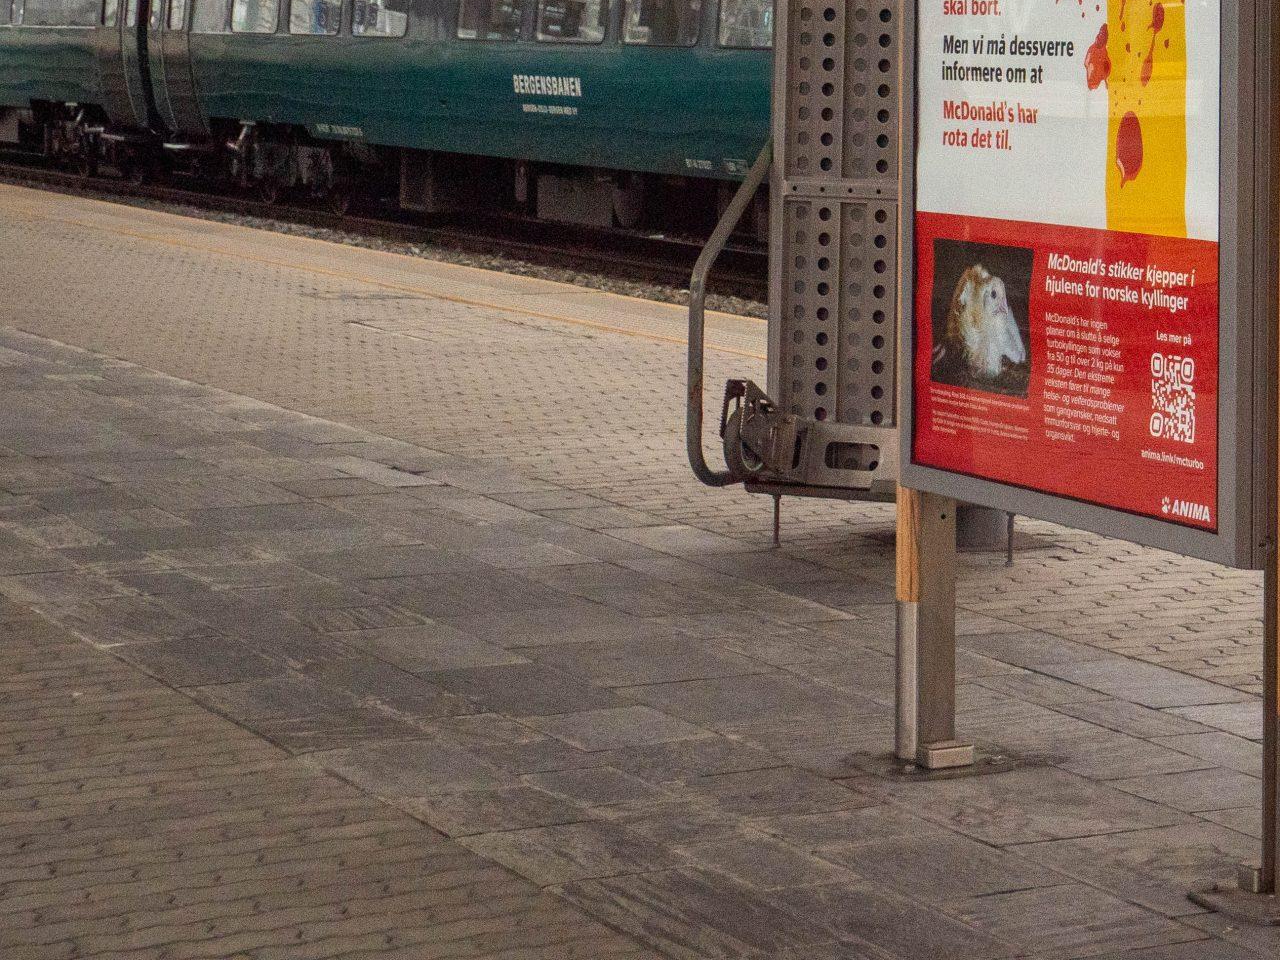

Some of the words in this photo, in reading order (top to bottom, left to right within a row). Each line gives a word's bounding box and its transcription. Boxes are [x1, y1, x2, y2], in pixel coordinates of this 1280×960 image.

[513, 75, 581, 96] BERGENSBANEN
[1048, 253, 1105, 276] McDonald's
[1109, 261, 1144, 281] stikker
[1146, 265, 1188, 288] kjepper
[1191, 269, 1195, 286] i
[1046, 276, 1083, 296] hjulene
[1085, 281, 1100, 298] for
[1103, 287, 1138, 303] norske
[1142, 288, 1188, 313] kyllinger
[1172, 499, 1210, 522] ANIMA
